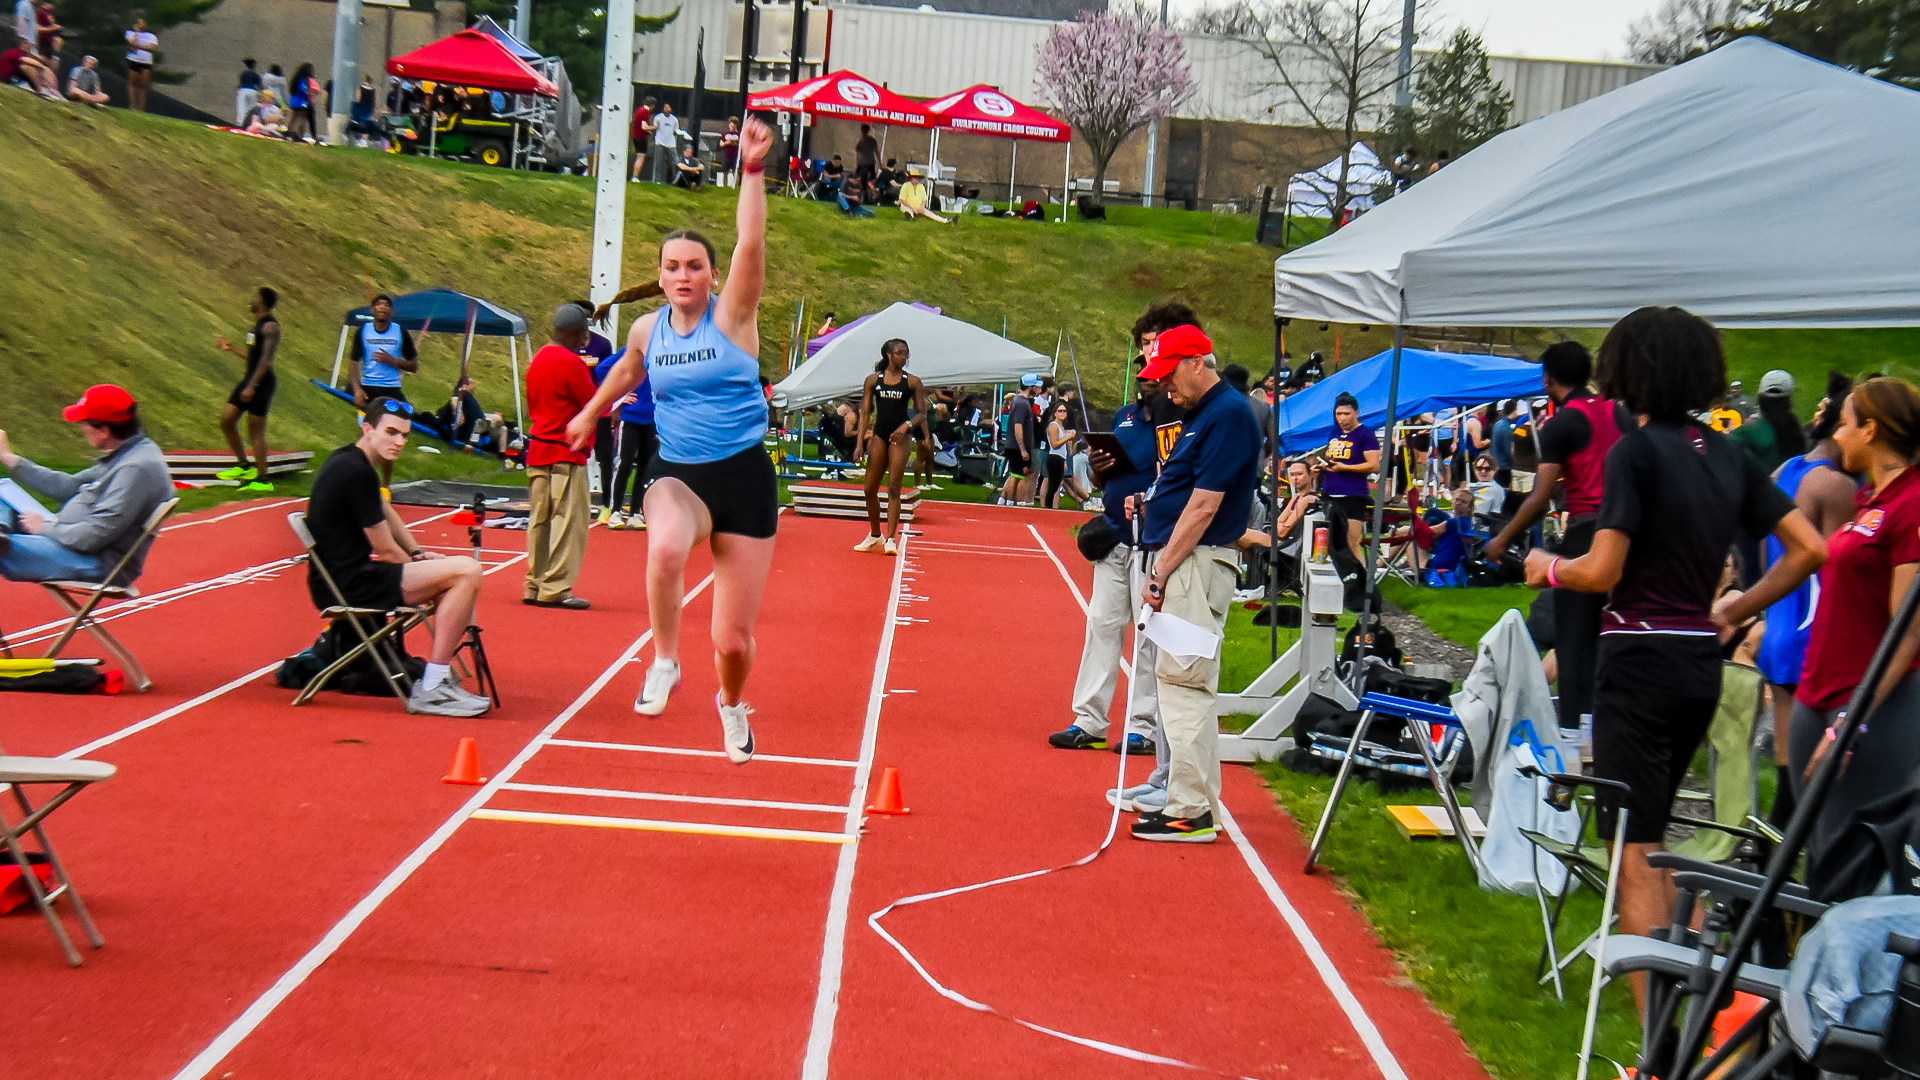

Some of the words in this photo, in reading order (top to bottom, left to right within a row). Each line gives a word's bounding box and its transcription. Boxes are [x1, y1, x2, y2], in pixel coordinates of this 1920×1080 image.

[847, 85, 869, 101] S
[815, 101, 864, 116] SWARTHMORE
[866, 107, 888, 119] TRACK
[890, 111, 905, 122] AND
[905, 113, 925, 124] FIELD
[983, 97, 1004, 111] S
[951, 117, 1002, 132] SWARTHMORE
[1003, 123, 1024, 134] CROSS
[1025, 125, 1059, 138] COUNTRY
[655, 347, 717, 367] WIDENER
